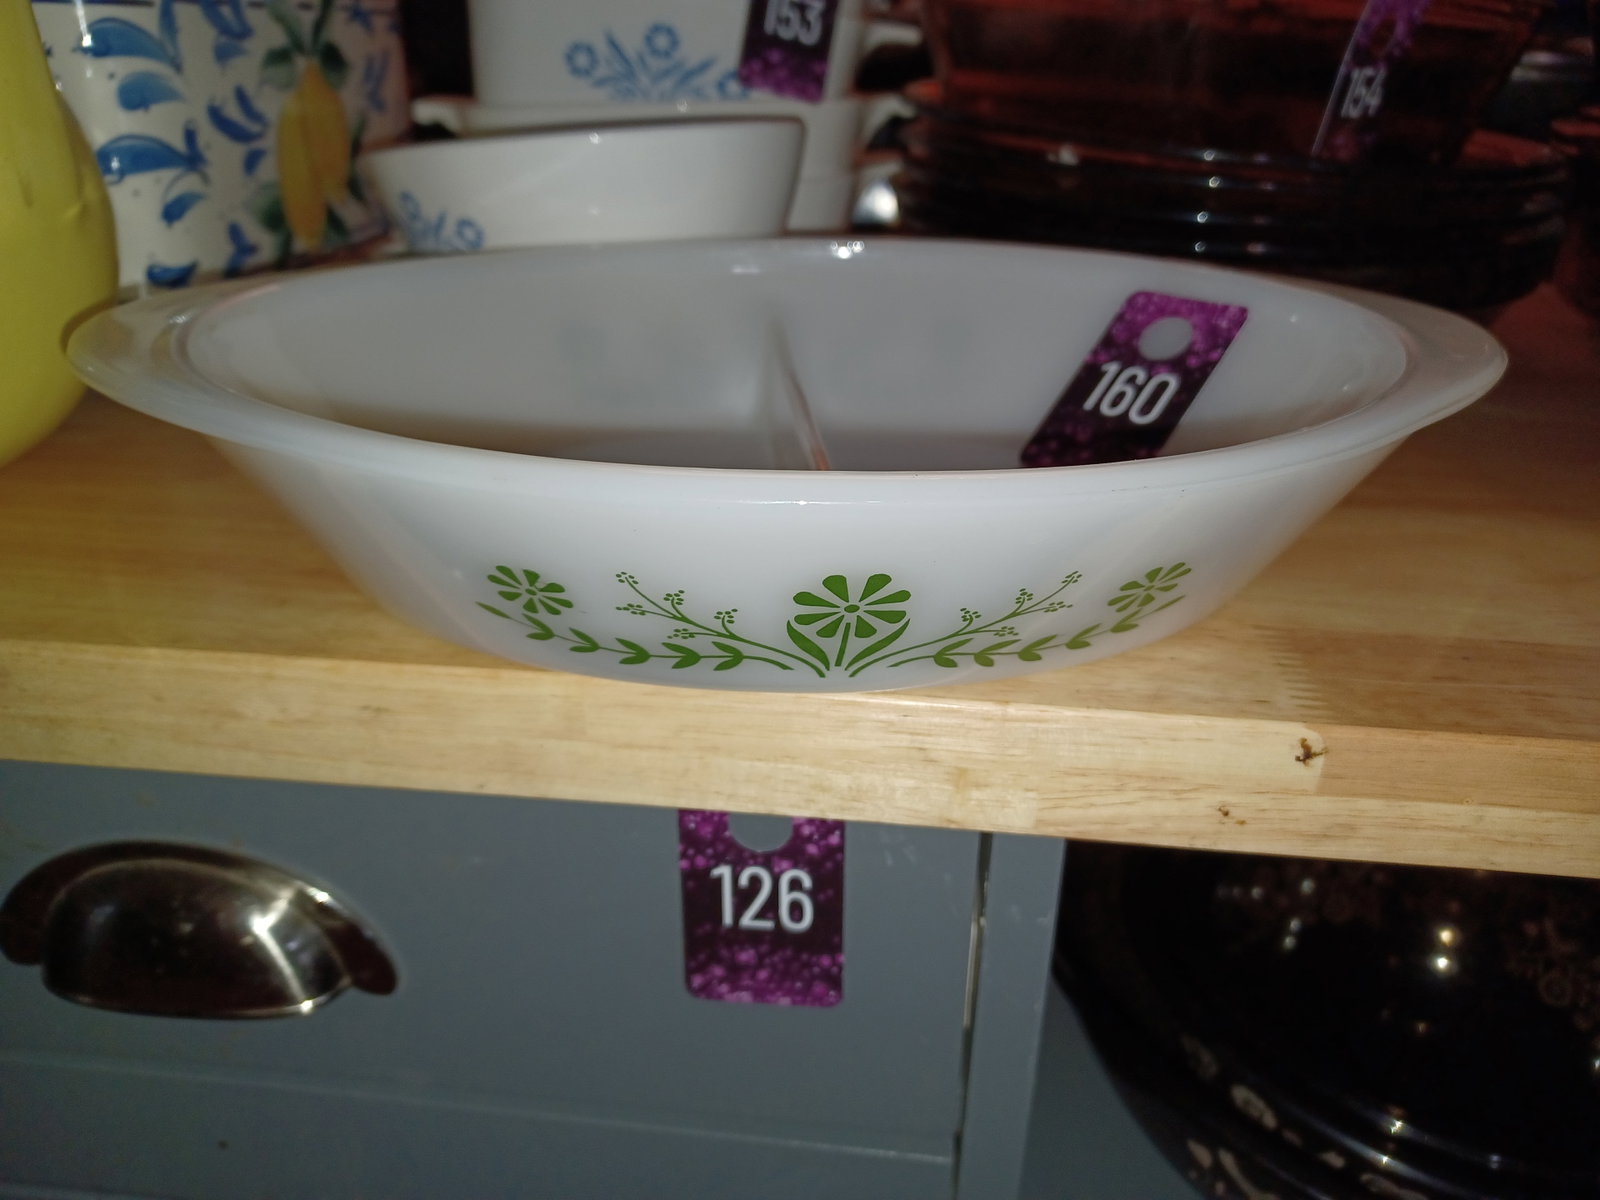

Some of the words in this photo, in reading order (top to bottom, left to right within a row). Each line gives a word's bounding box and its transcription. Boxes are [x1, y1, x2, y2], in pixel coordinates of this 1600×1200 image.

[1340, 66, 1387, 119] 154
[1082, 361, 1181, 425] 160
[709, 864, 815, 933] 126
